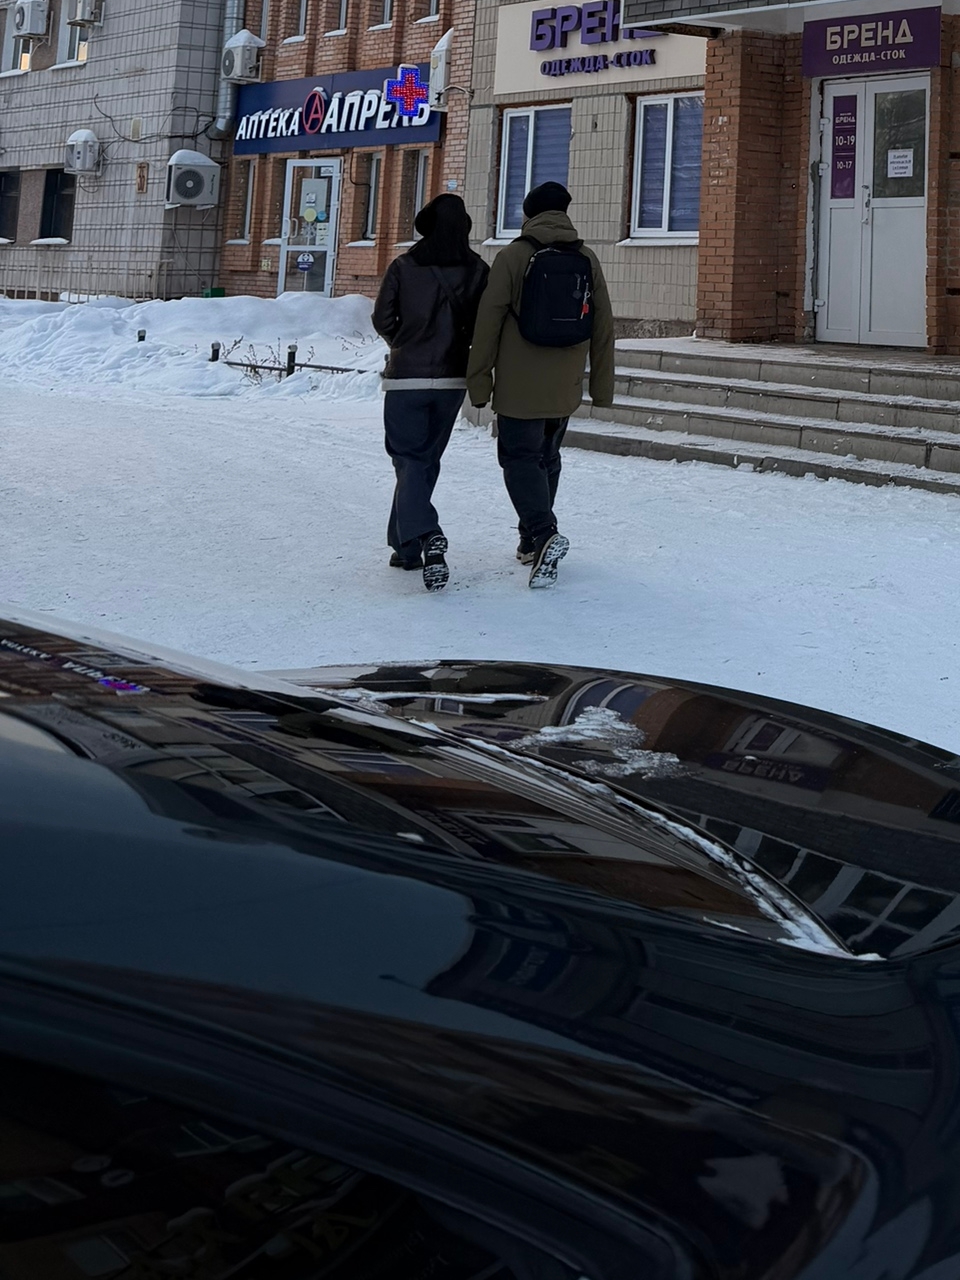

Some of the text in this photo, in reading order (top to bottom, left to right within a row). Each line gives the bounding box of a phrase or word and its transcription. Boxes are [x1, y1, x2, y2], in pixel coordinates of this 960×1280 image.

[826, 18, 914, 51] БРЕНД
[540, 49, 656, 77] ОДЕЖДА-СТОК
[832, 49, 907, 65] ОДЕЖДА-СТОК
[235, 110, 300, 141] АПТЕКА
[835, 134, 855, 146] 10-19
[836, 160, 853, 170] 10-17
